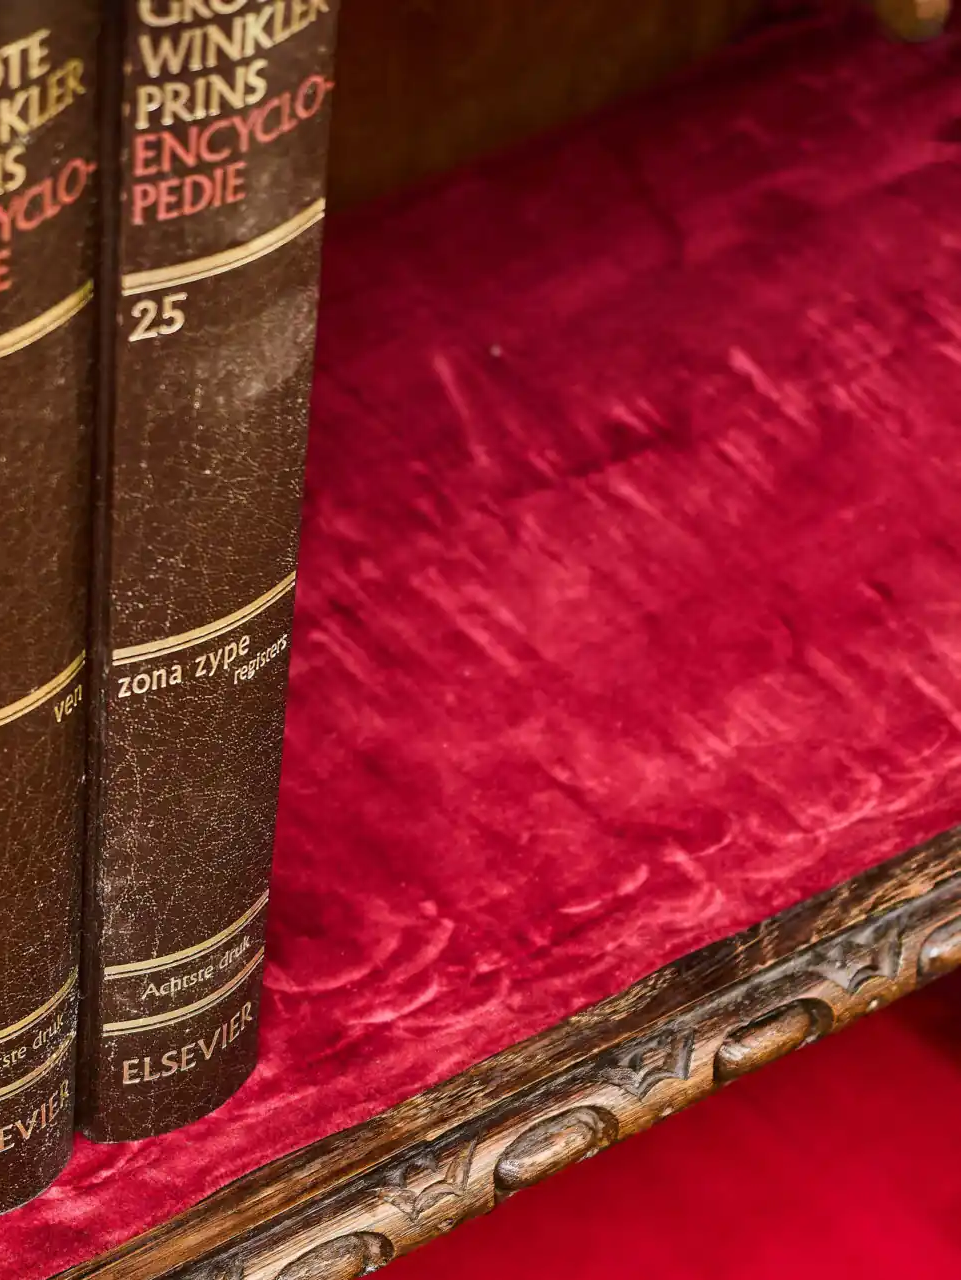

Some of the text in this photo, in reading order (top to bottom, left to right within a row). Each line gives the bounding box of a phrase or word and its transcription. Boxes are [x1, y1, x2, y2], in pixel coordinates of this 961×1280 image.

[133, 74, 335, 177] ENCYCLO-
[135, 59, 268, 129] PRINS
[132, 161, 247, 226] PEDIE
[129, 292, 188, 342] 25
[118, 635, 250, 698] zona zype
[234, 633, 288, 684] registers
[54, 684, 82, 722] ven
[141, 935, 251, 1000] Achtste druk
[33, 1014, 64, 1050] druk
[122, 1001, 253, 1085] ELSEVIER
